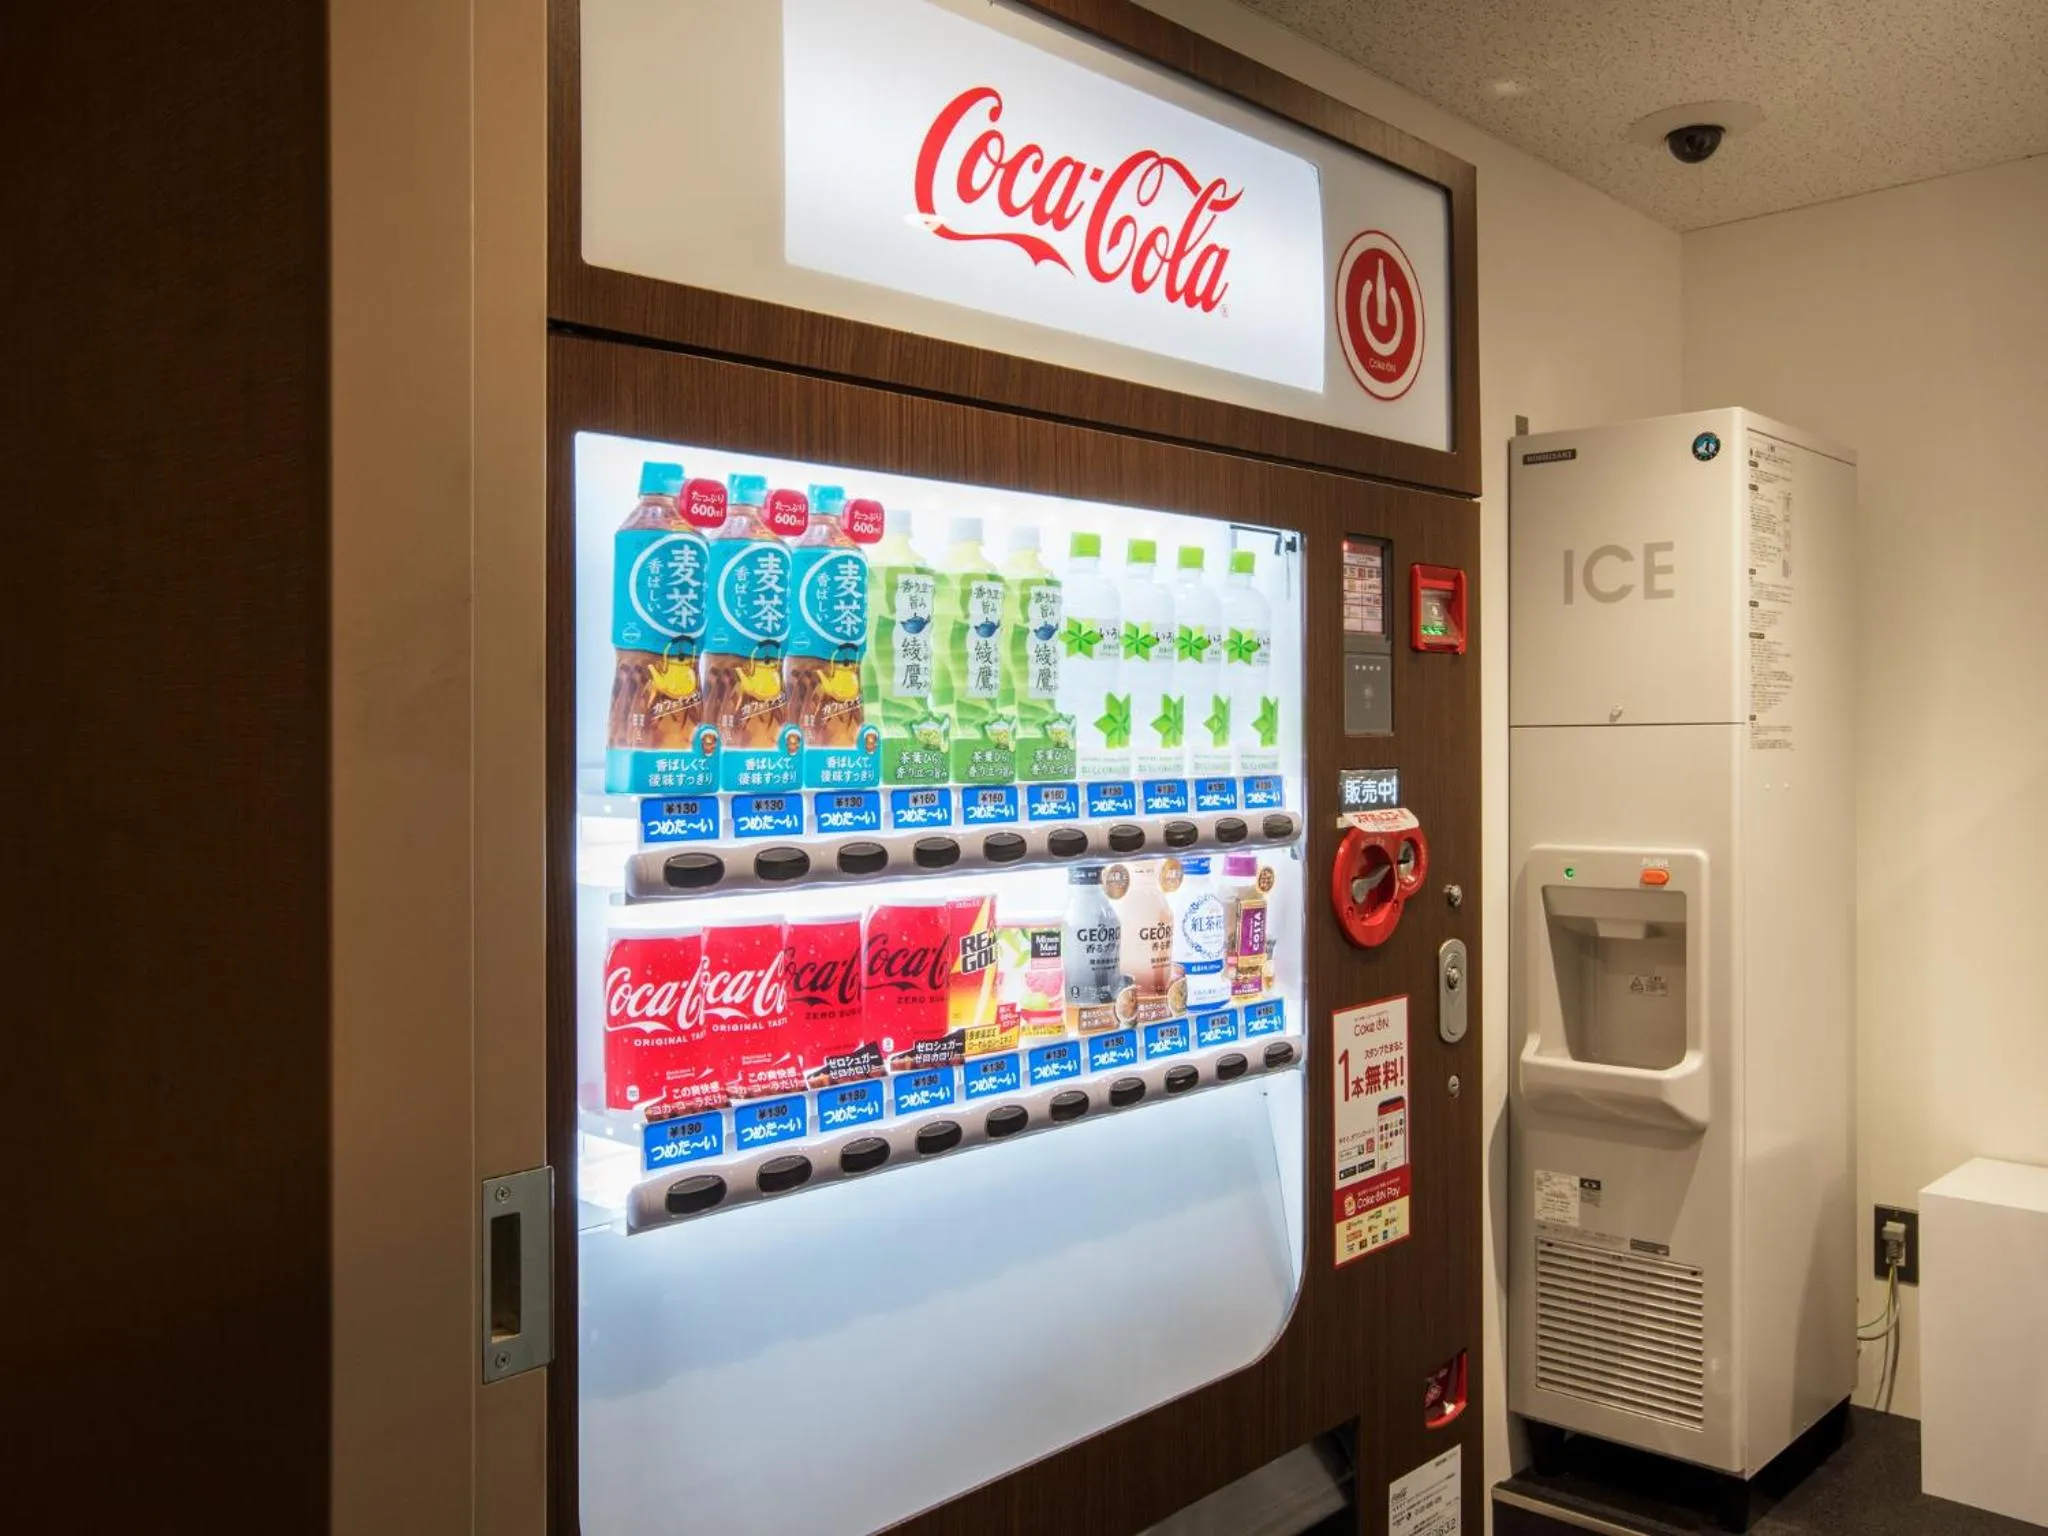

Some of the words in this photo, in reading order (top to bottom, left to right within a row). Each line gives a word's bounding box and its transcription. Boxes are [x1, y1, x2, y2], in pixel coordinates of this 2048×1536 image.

[914, 86, 1244, 313] Coca-Cola
[690, 490, 724, 503] たっぷり
[774, 500, 807, 513] たっぷり
[853, 508, 880, 522] たっぷり
[1563, 541, 1674, 605] ICE
[648, 557, 662, 613] 香ばしい
[666, 544, 704, 628] 麦茶
[735, 564, 749, 620] 香ばしい
[751, 552, 786, 634] 麦茶
[816, 570, 829, 624] 香ばしい
[830, 559, 865, 637] 麦茶
[901, 636, 923, 690] 綾鷹
[973, 640, 994, 691] 綾鷹
[1033, 643, 1054, 692] 綾鷹
[648, 772, 713, 788] 後味すっきり
[738, 770, 799, 787] 後味すっきり
[820, 770, 876, 786] 後味すっきり
[1345, 777, 1393, 804] 販売中
[667, 802, 698, 816] ¥130
[755, 799, 785, 813] ¥130
[835, 797, 864, 810] ¥130
[897, 996, 926, 1004] ZERO
[805, 1011, 836, 1020] ZERO
[711, 1021, 765, 1033] ORIGINAL
[633, 1036, 689, 1048] ORIGINAL
[915, 1041, 963, 1055] ゼロシュガー
[828, 1054, 880, 1069] ゼロシュガー
[1045, 1048, 1067, 1061] ¥130
[759, 1105, 788, 1120] ¥130
[669, 1122, 702, 1137] ¥130
